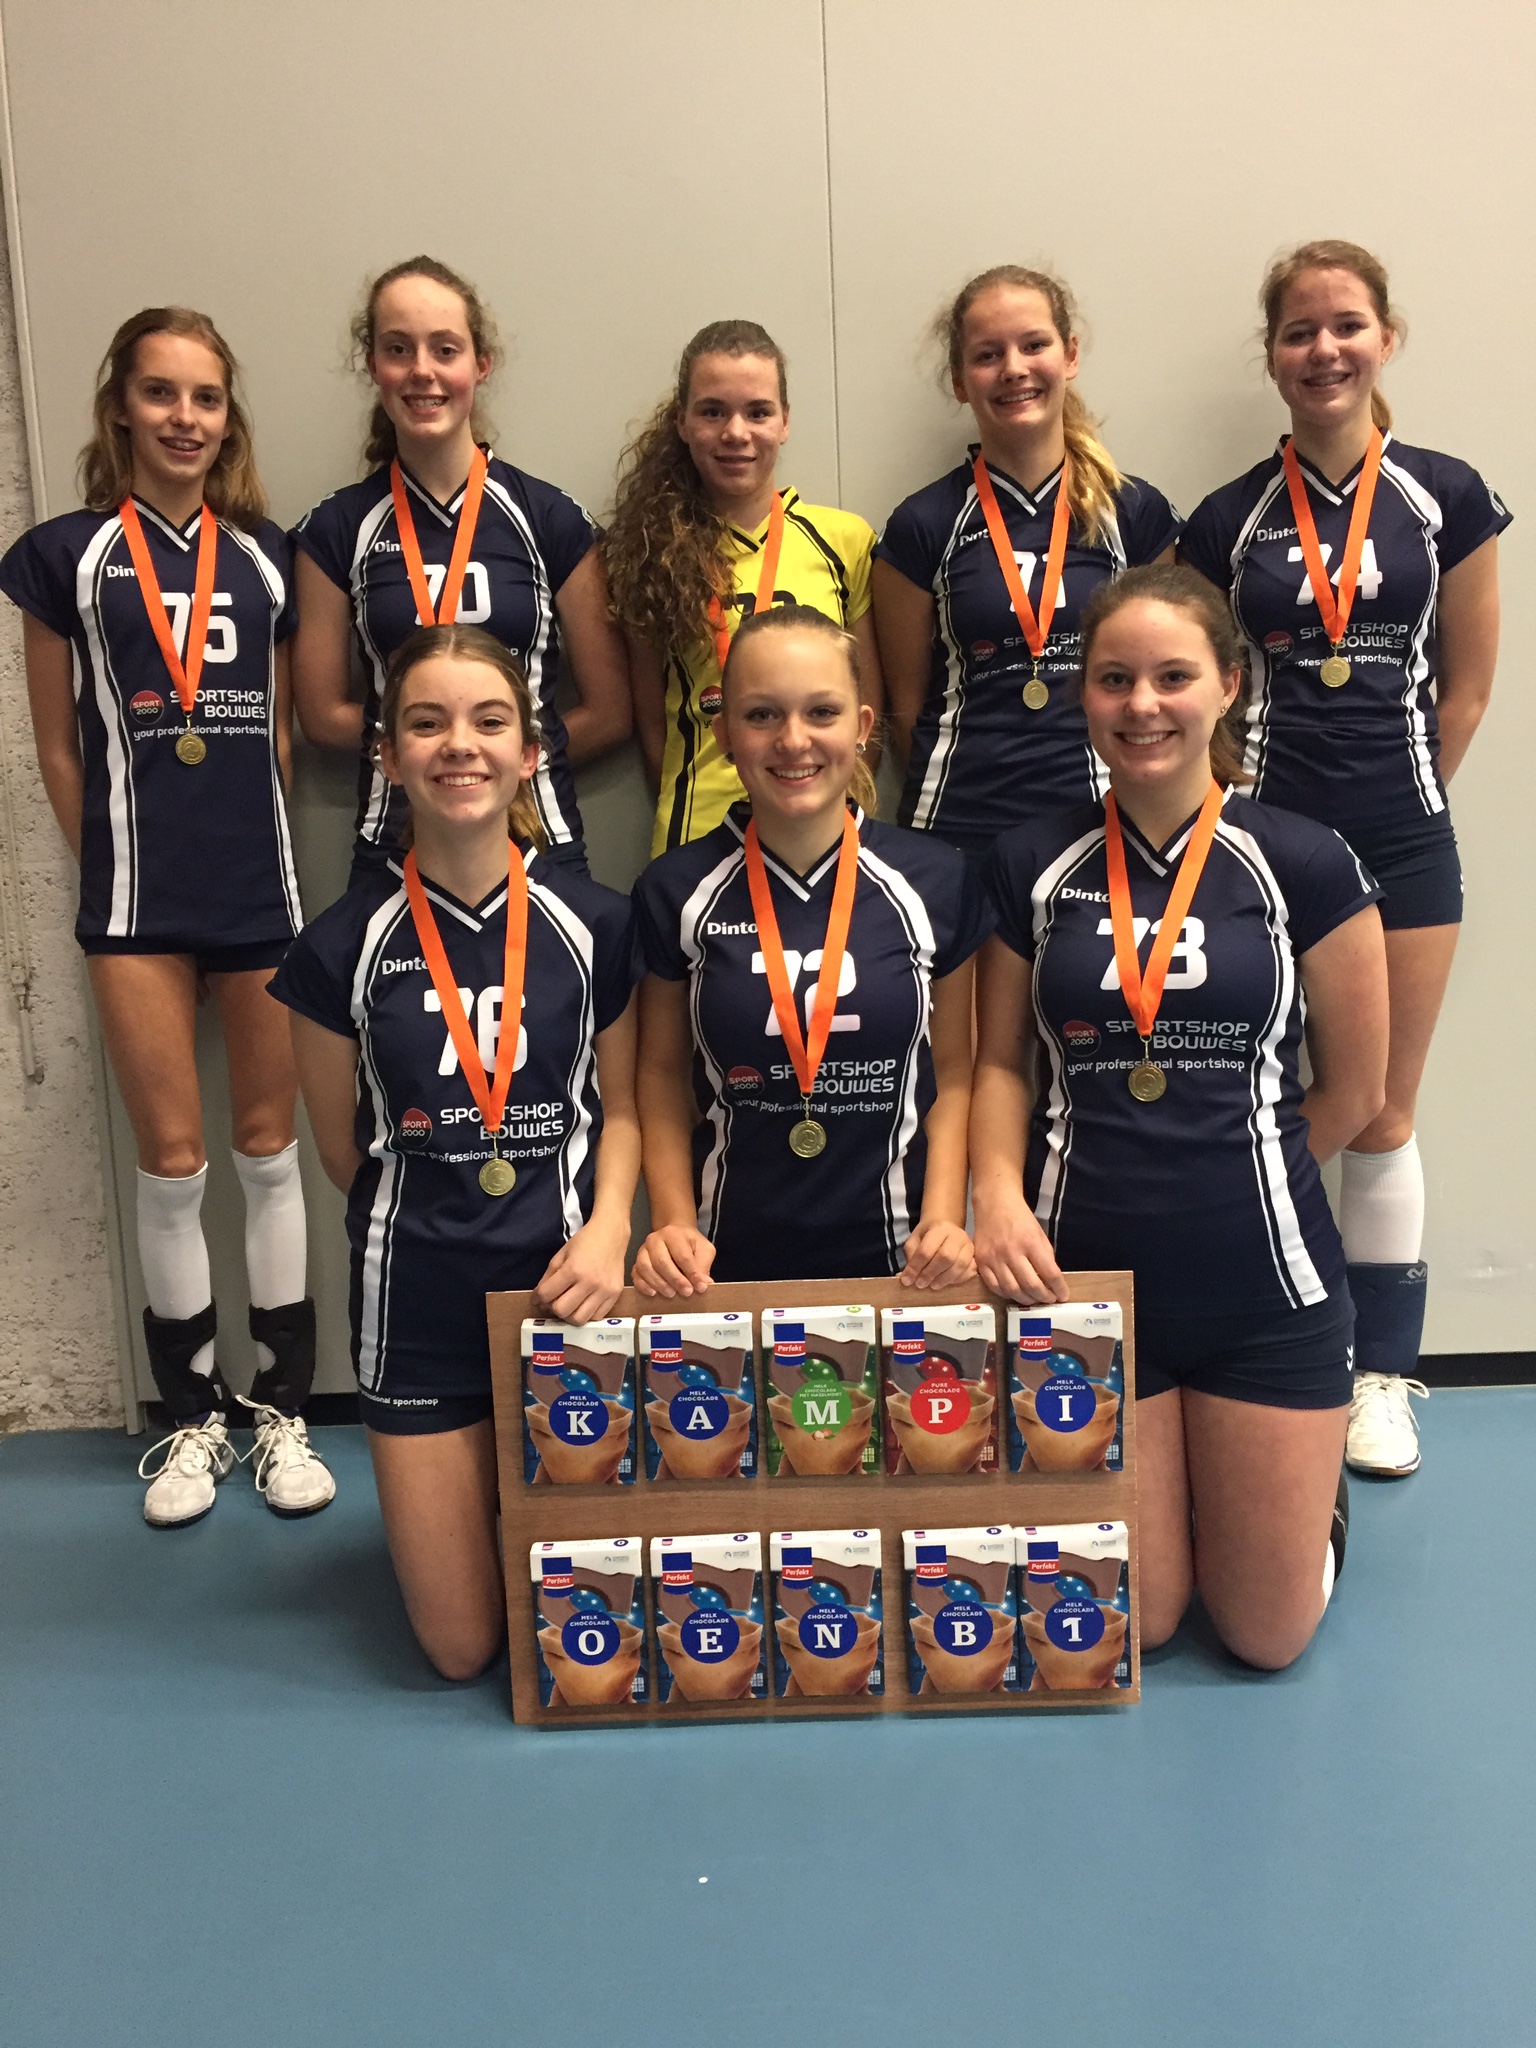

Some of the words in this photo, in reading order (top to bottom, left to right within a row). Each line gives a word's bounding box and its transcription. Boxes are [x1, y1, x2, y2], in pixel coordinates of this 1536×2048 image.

[959, 528, 992, 547] Dint
[374, 539, 403, 553] Din
[106, 565, 138, 578] Din
[1287, 538, 1383, 606] 74
[407, 561, 492, 626] 70
[159, 592, 238, 664] 75
[1300, 622, 1409, 640] SPTSHOP
[1003, 632, 1085, 648] SPTSH
[1039, 645, 1083, 657] BOUW
[1047, 663, 1083, 673] sports
[1354, 654, 1403, 667] sportshop
[132, 699, 160, 710] SPORT
[169, 689, 264, 704] SORTSHOP
[136, 707, 158, 715] 2000
[204, 705, 266, 719] BOUWES
[133, 729, 158, 742] your
[1096, 916, 1208, 991] 73
[751, 949, 861, 1037] 72
[423, 985, 528, 1076] 76
[1066, 1029, 1095, 1039] SPORT
[1105, 1020, 1250, 1037] SPRTSHOP
[1070, 1037, 1095, 1046] 2000
[1153, 1035, 1247, 1053] BOUWES
[769, 1059, 896, 1080] SPRTSHOP
[1067, 1062, 1094, 1076] your
[1177, 1057, 1245, 1072] sportshop
[728, 1075, 760, 1085] SPORT
[733, 1082, 759, 1091] 2000
[812, 1077, 894, 1095] BOUWES
[439, 1102, 564, 1125] SPOTSHOP
[830, 1101, 894, 1116] sportshop
[402, 1120, 428, 1129] SPORT
[401, 1129, 426, 1137] 2000
[1023, 1339, 1048, 1347] Perfekt
[536, 1354, 561, 1362] Perfekt
[392, 1398, 439, 1407] sportshop
[1058, 1394, 1074, 1422] I
[686, 1405, 714, 1431] A
[802, 1399, 841, 1426] M
[927, 1398, 953, 1424] P
[566, 1410, 595, 1436] K
[919, 1566, 944, 1574] Perfekt
[1031, 1562, 1056, 1570] Perfekt
[546, 1577, 570, 1585] Perfekt
[942, 1610, 983, 1618] CHOCOLADE
[813, 1623, 843, 1649] N
[950, 1620, 977, 1647] B
[1062, 1616, 1083, 1642] 1
[578, 1629, 605, 1656] O
[696, 1628, 723, 1654] E
